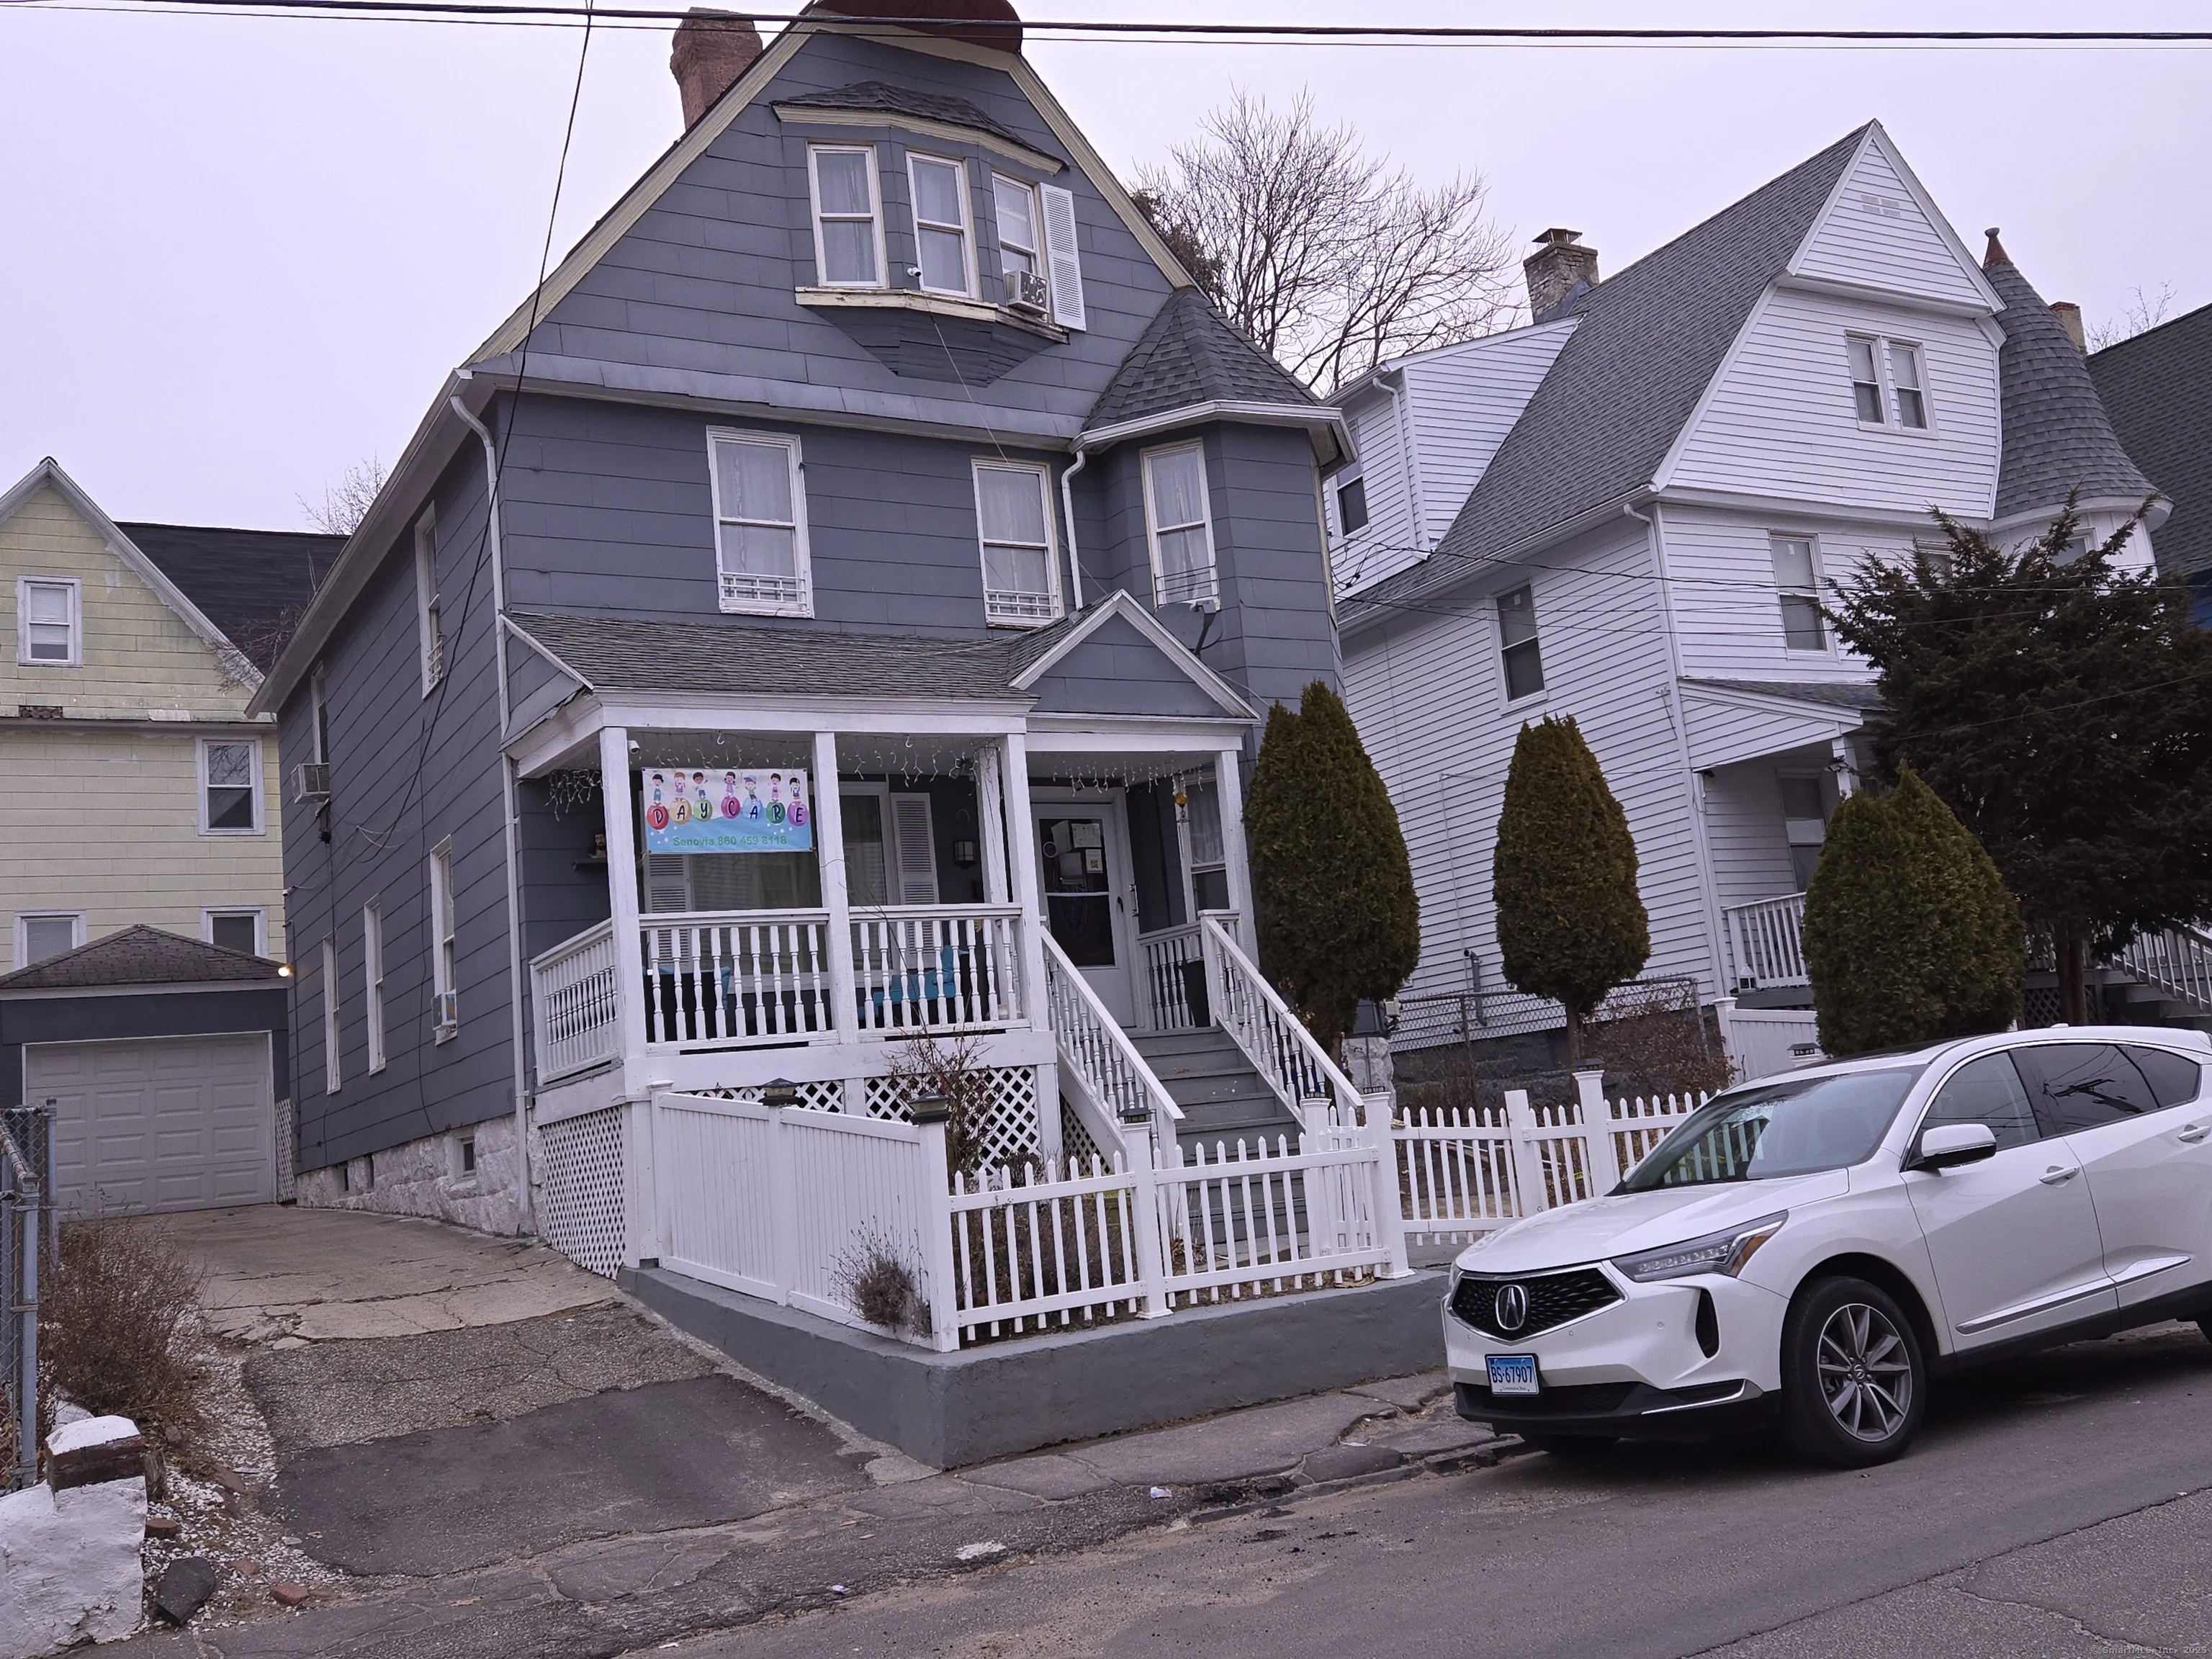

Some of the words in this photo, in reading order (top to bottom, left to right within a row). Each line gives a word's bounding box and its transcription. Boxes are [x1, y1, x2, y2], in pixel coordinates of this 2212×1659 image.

[728, 800, 804, 822] CARE
[673, 836, 714, 847] Senovia
[717, 836, 737, 846] 860
[740, 835, 758, 845] 459
[762, 835, 787, 845] 8118
